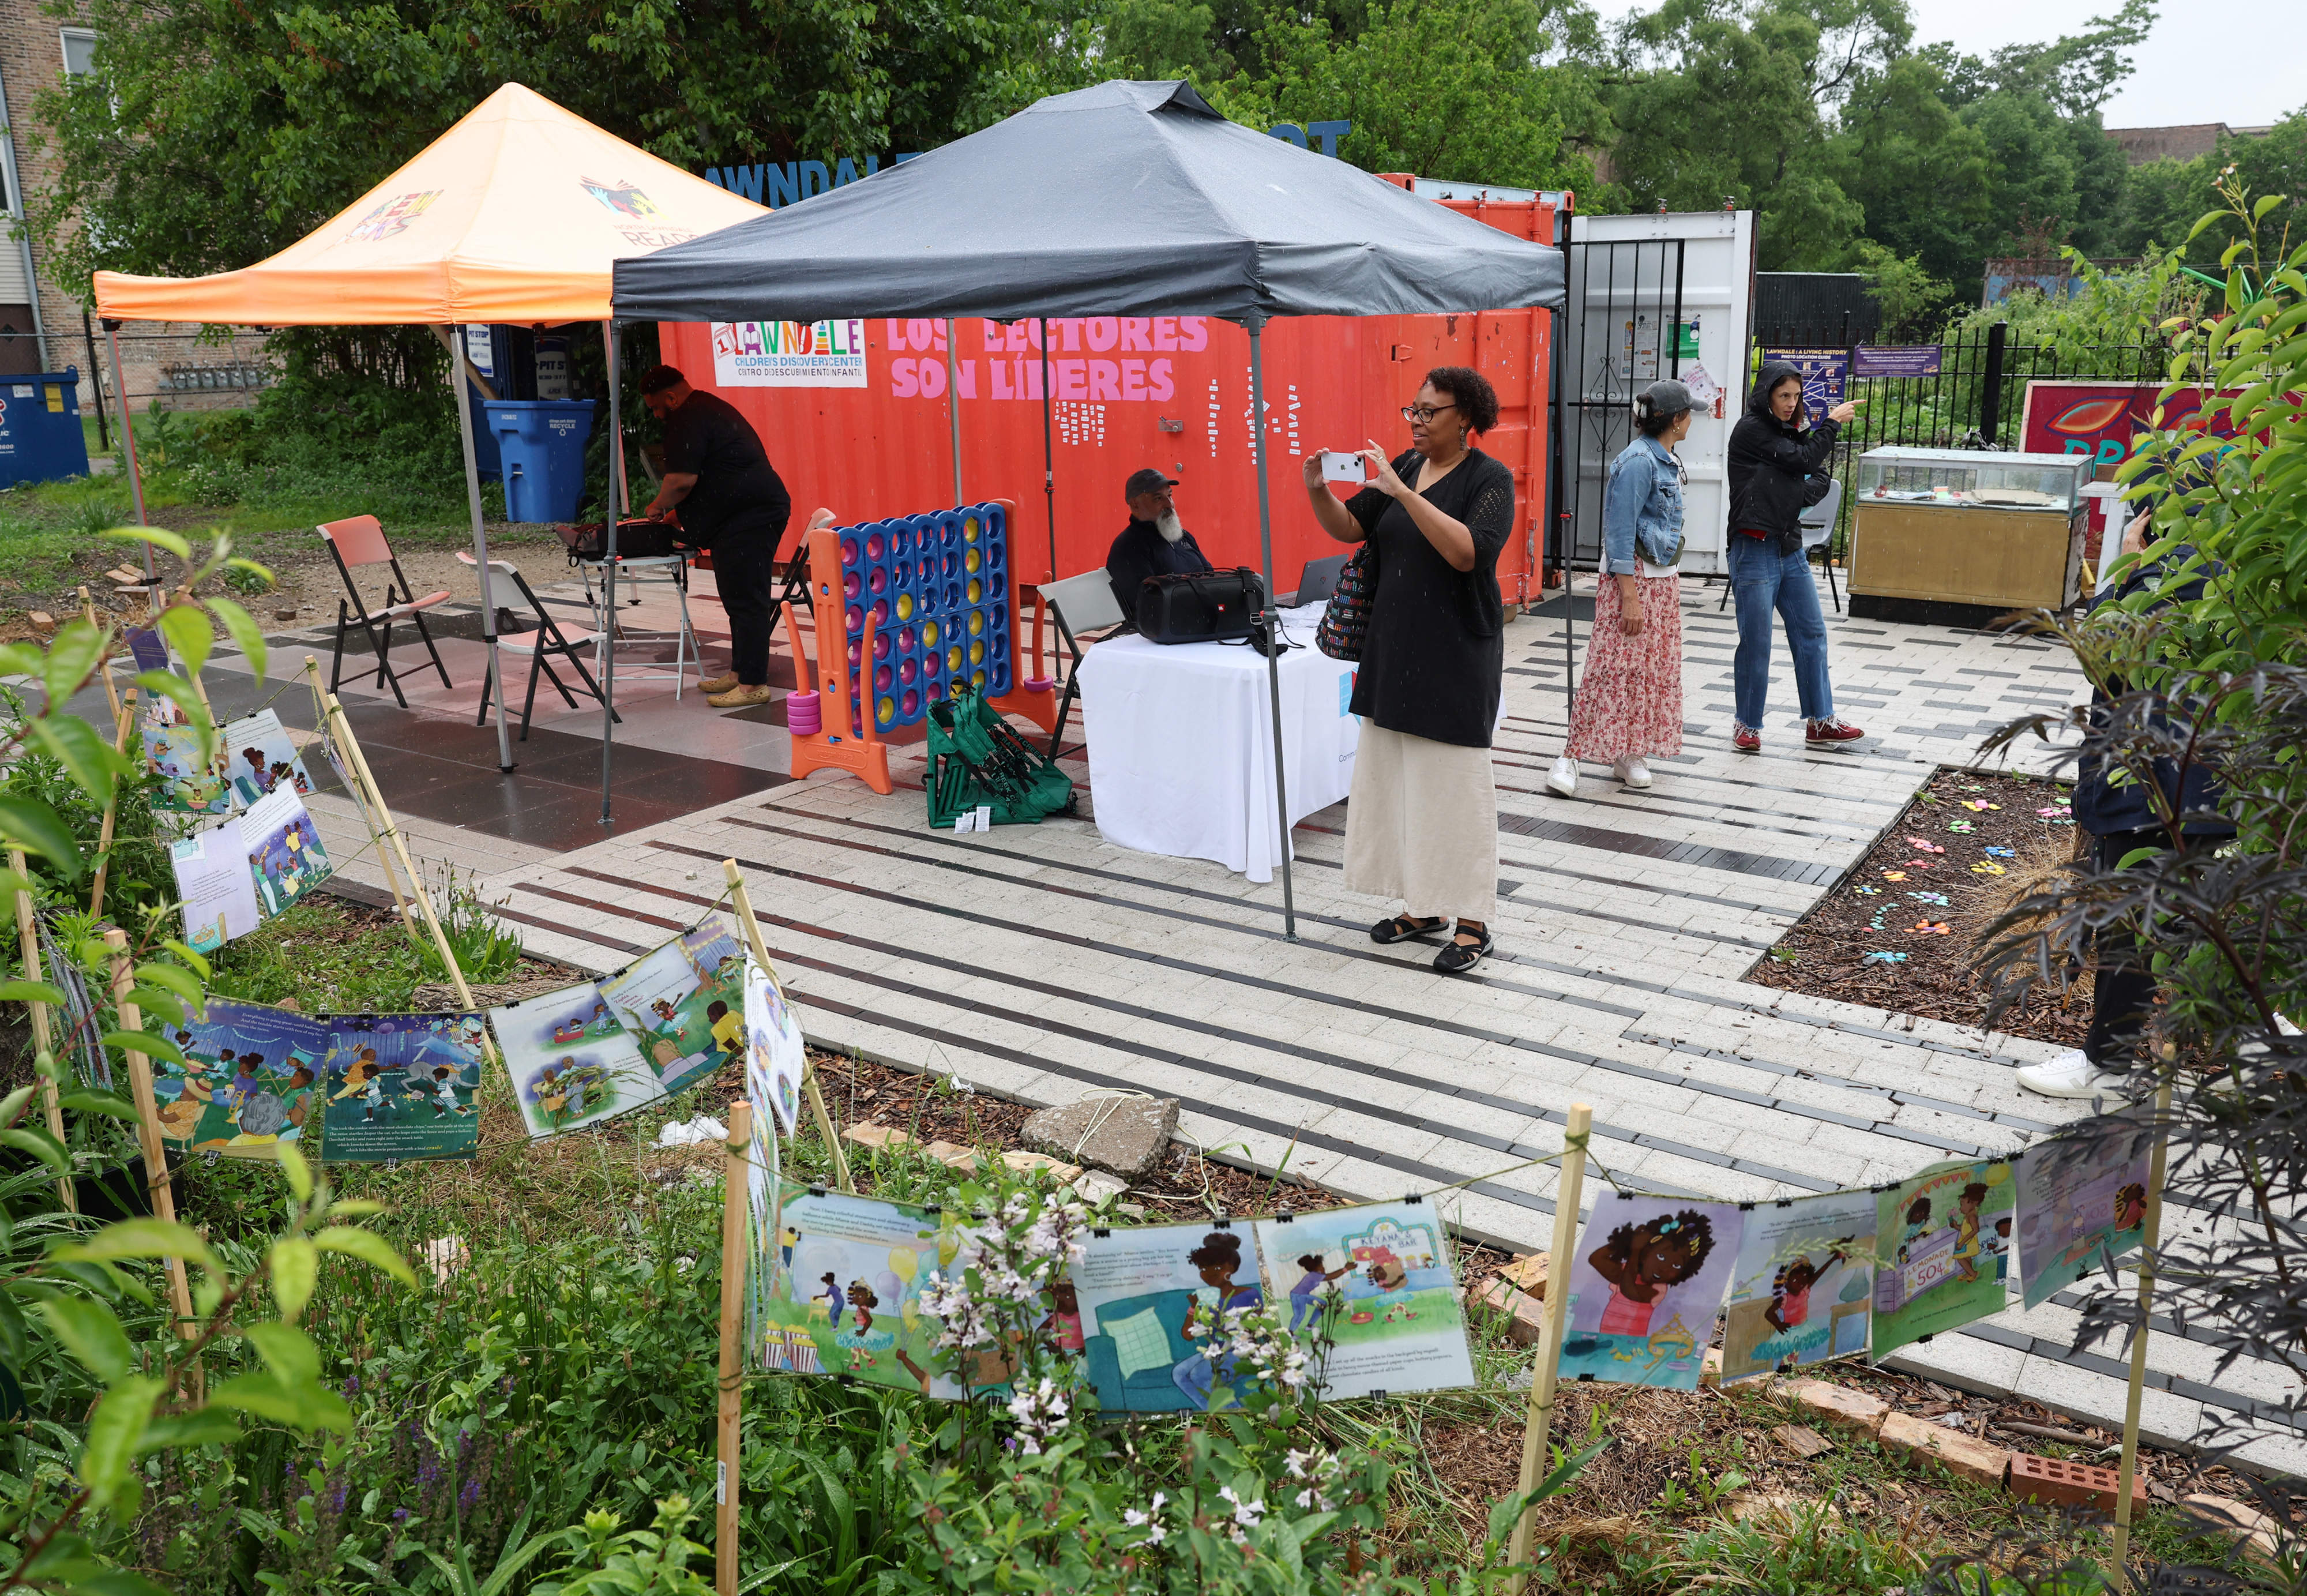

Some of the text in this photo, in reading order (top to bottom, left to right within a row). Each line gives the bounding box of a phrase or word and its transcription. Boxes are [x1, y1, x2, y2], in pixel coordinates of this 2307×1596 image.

[475, 331, 489, 339] STOP
[886, 316, 1208, 352] LOS LECTORES
[539, 360, 555, 370] PIT
[780, 357, 828, 366] DISCOVERY
[829, 358, 862, 366] CENTER
[891, 352, 1175, 402] SON LÍDERES
[1907, 1248, 1949, 1275] LEMONADE
[1917, 1261, 1946, 1286] 50¢
